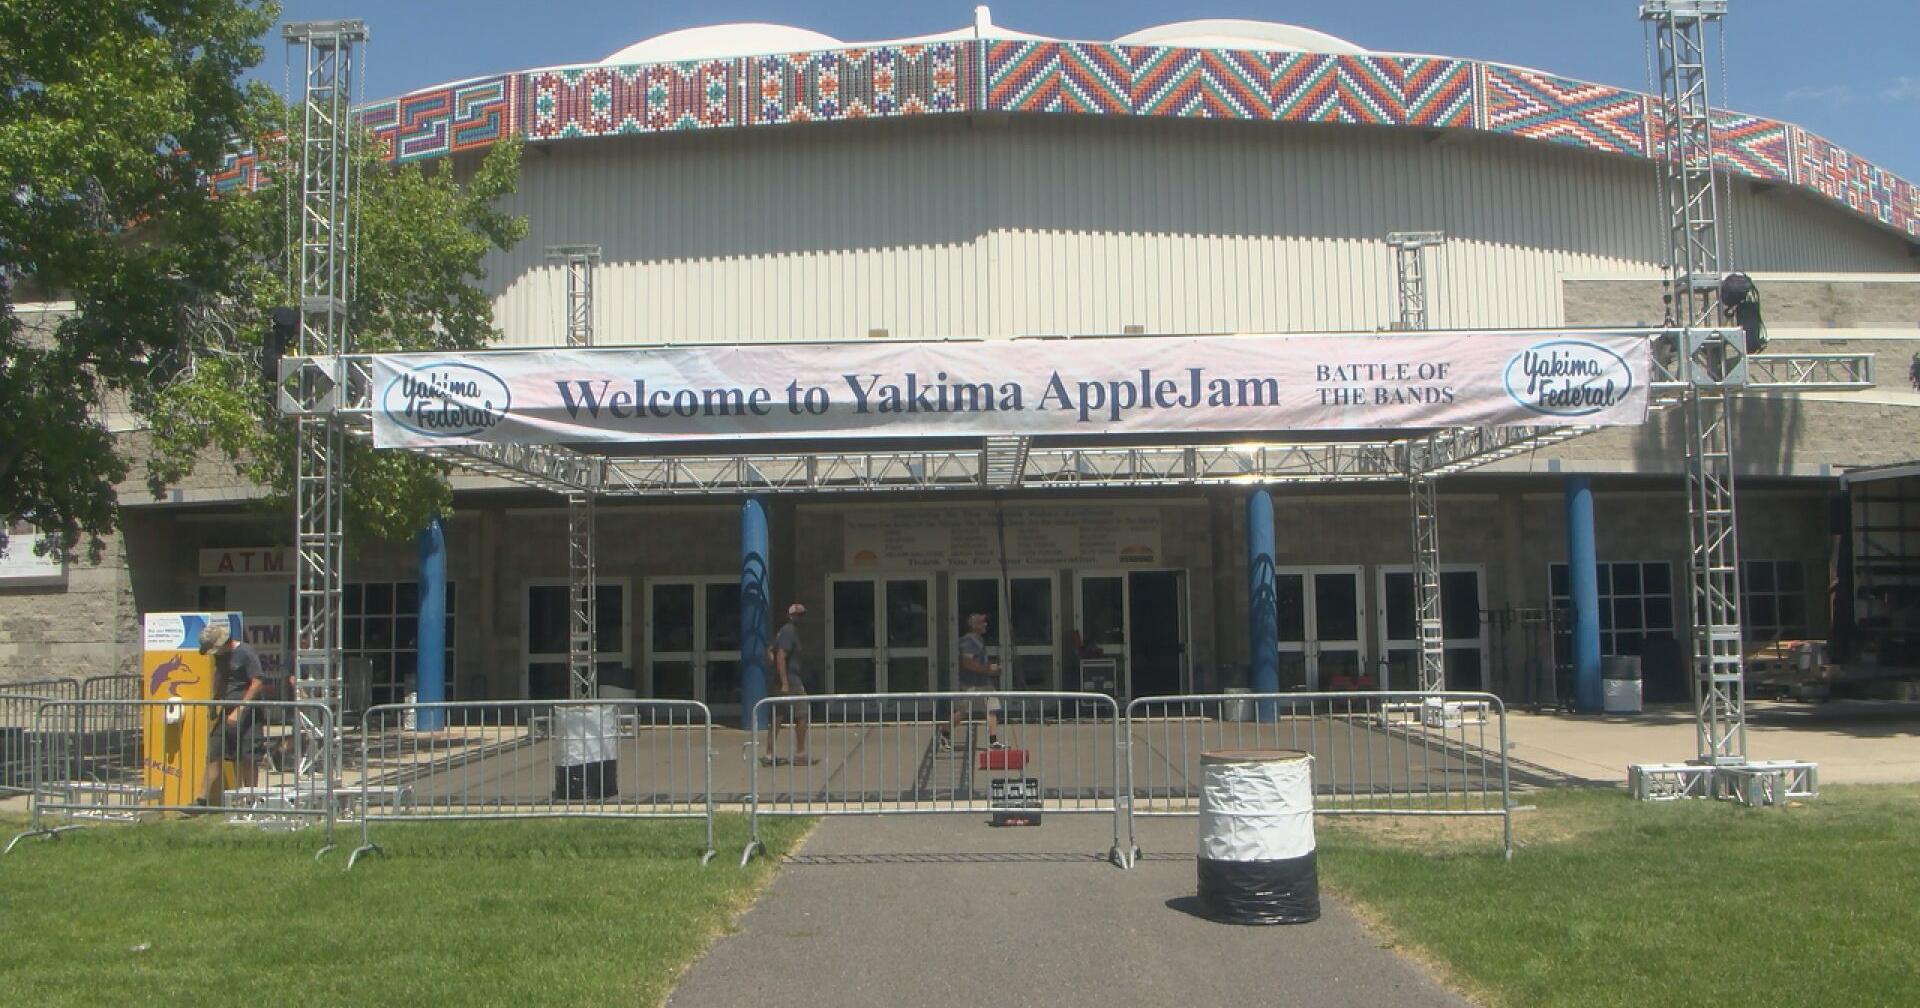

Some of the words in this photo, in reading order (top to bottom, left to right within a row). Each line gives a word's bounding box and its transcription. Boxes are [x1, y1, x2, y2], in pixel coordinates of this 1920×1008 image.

[1316, 363, 1411, 381] BATTLE
[1418, 362, 1450, 380] OF
[1523, 351, 1602, 394] Yakima
[402, 373, 480, 417] Yakima
[555, 379, 771, 420] Welcome
[786, 378, 829, 416] to
[843, 372, 1024, 415] Yakima
[1038, 368, 1279, 421] AppleJam
[1316, 387, 1366, 404] THE
[1374, 385, 1454, 404] BANDS
[1539, 378, 1615, 406] Federal
[417, 399, 496, 427] Federal
[218, 551, 284, 572] ATM
